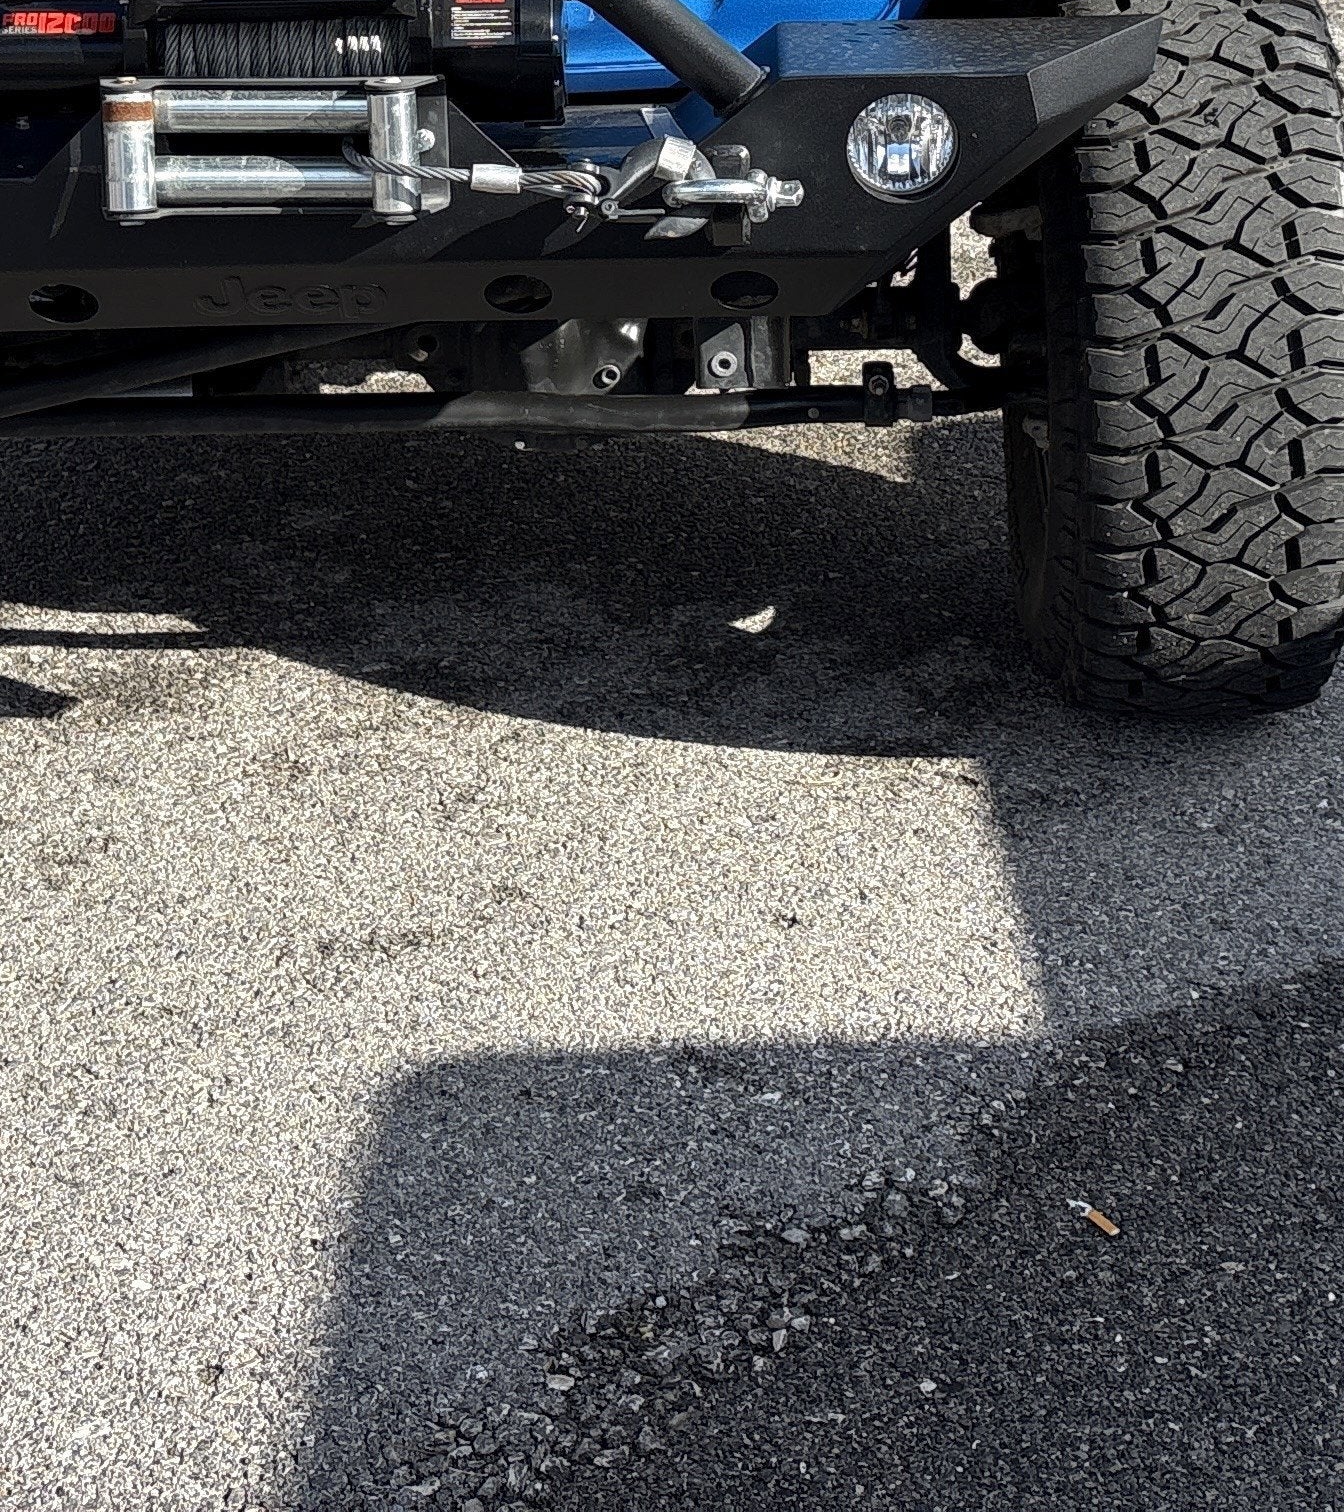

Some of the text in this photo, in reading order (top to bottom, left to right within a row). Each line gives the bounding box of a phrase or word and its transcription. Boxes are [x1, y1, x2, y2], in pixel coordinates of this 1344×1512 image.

[2, 13, 38, 26] PRO
[2, 26, 38, 35] SERIES
[193, 275, 389, 320] Jeep
